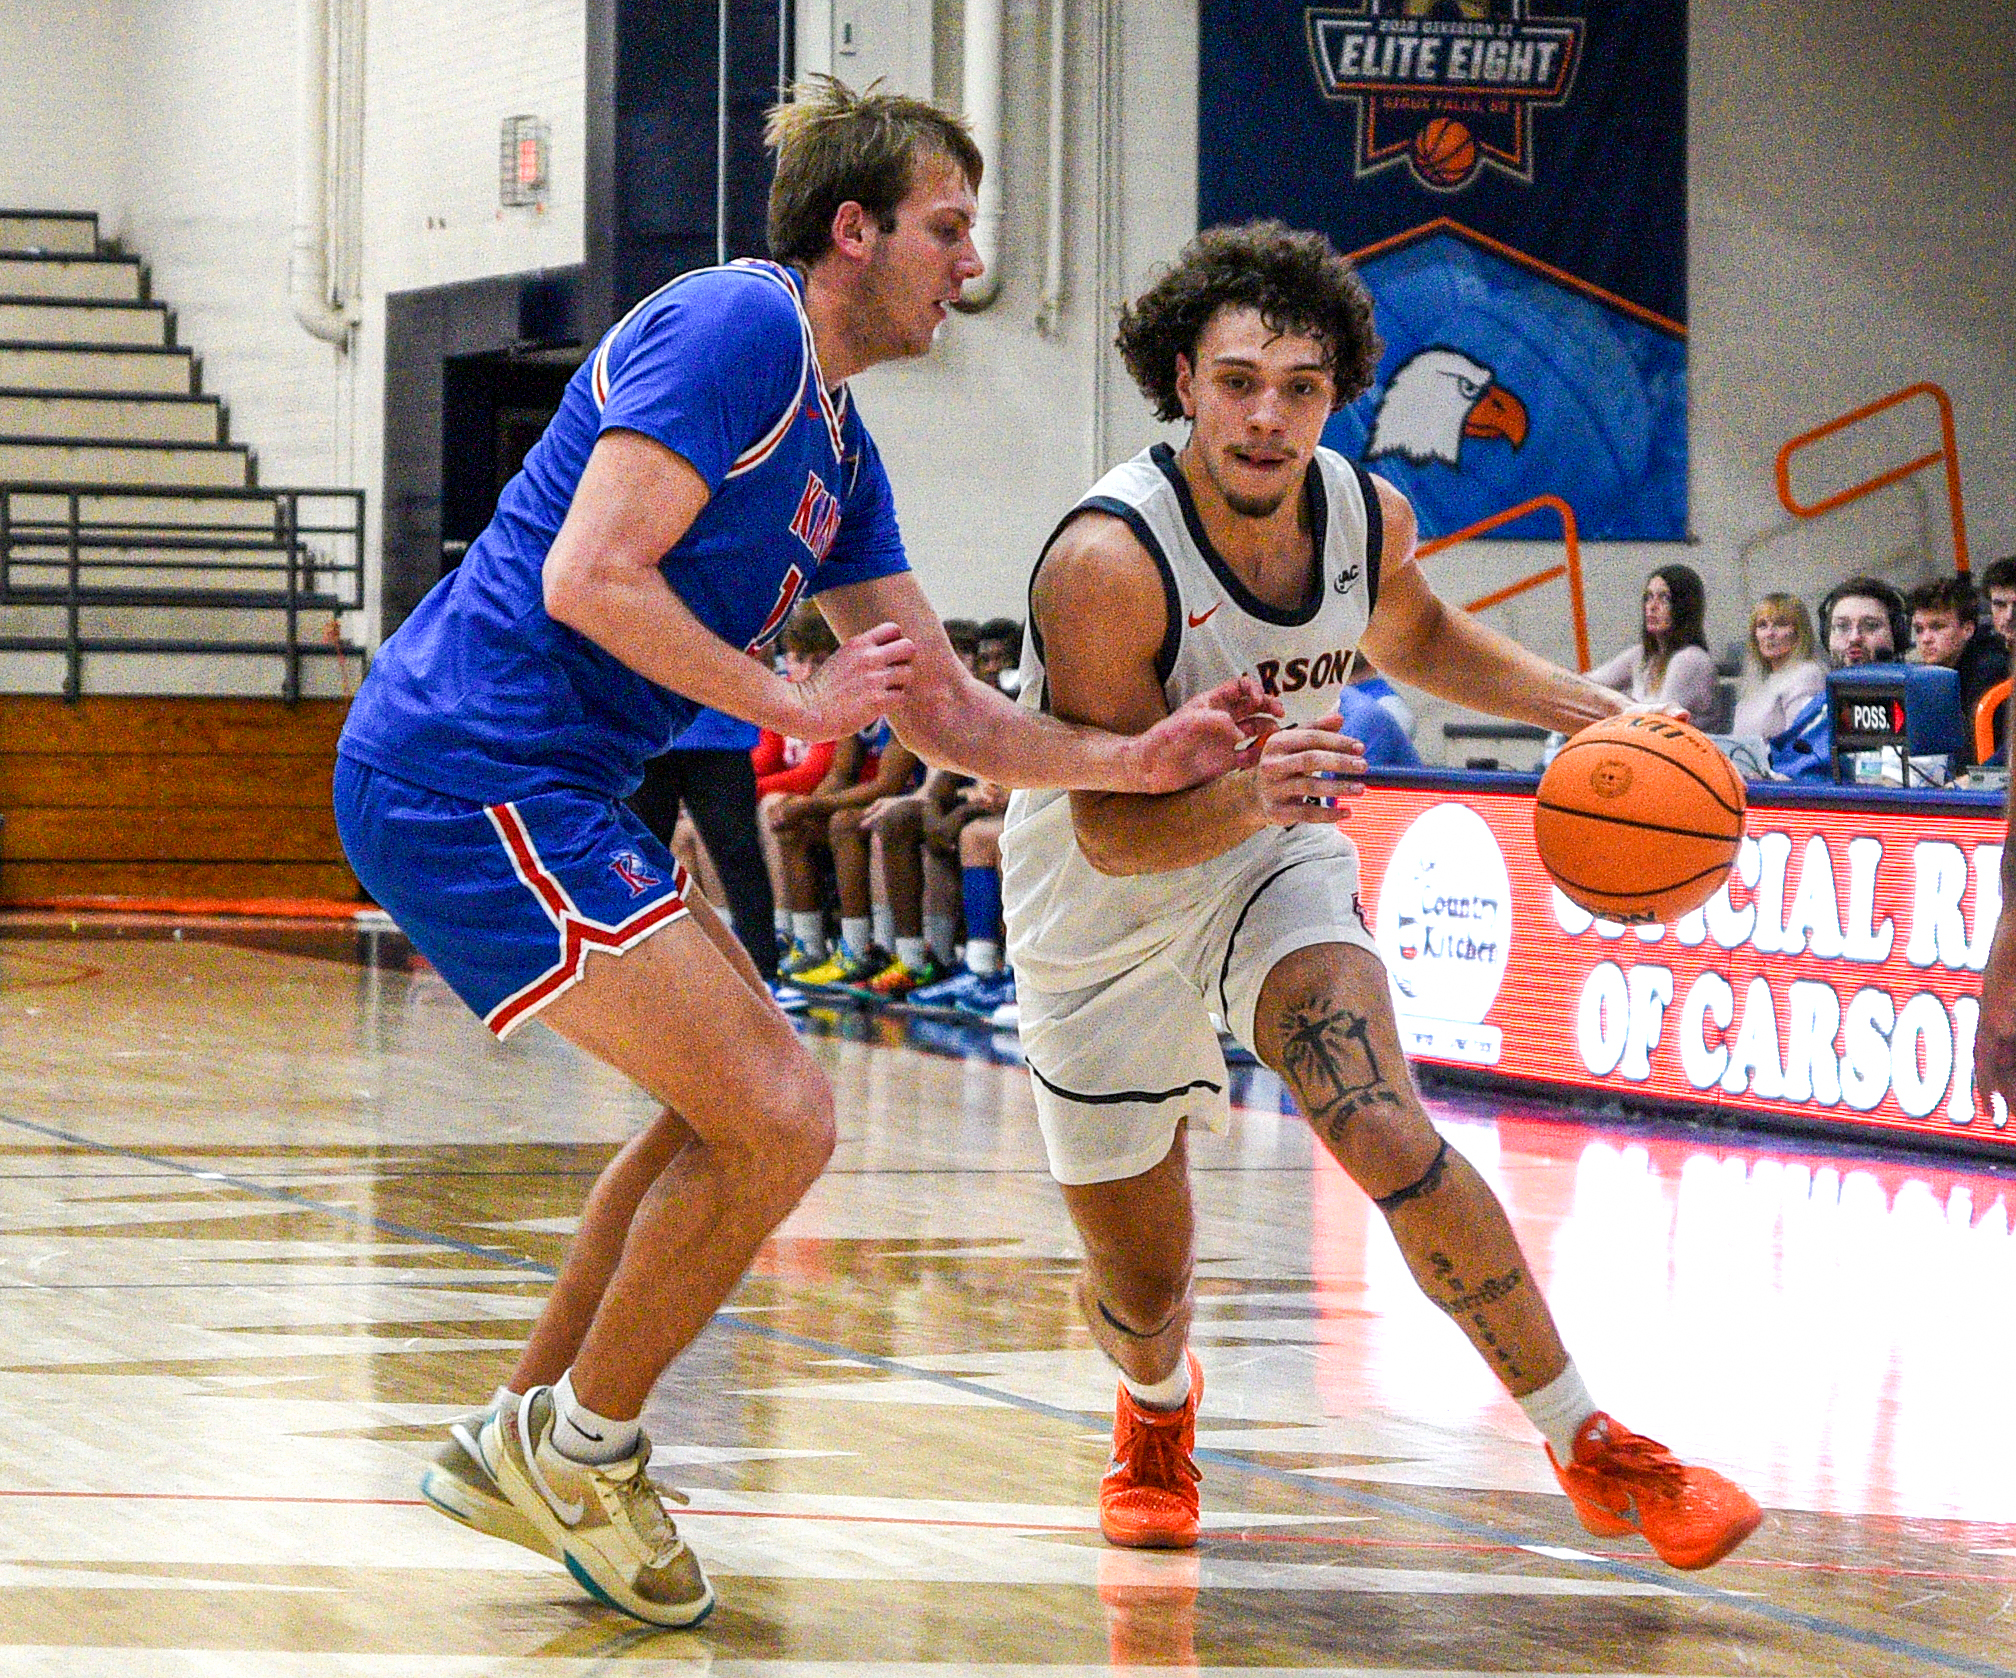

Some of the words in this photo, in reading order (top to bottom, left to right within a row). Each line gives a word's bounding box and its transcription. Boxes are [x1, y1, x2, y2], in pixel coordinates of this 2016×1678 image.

[1422, 21, 1495, 35] DIVISION
[1338, 34, 1442, 78] ELITE
[1448, 38, 1560, 82] EIGHT
[1255, 648, 1354, 697] RSON
[1853, 704, 1891, 730] POSS.
[1577, 960, 1675, 1081] OF
